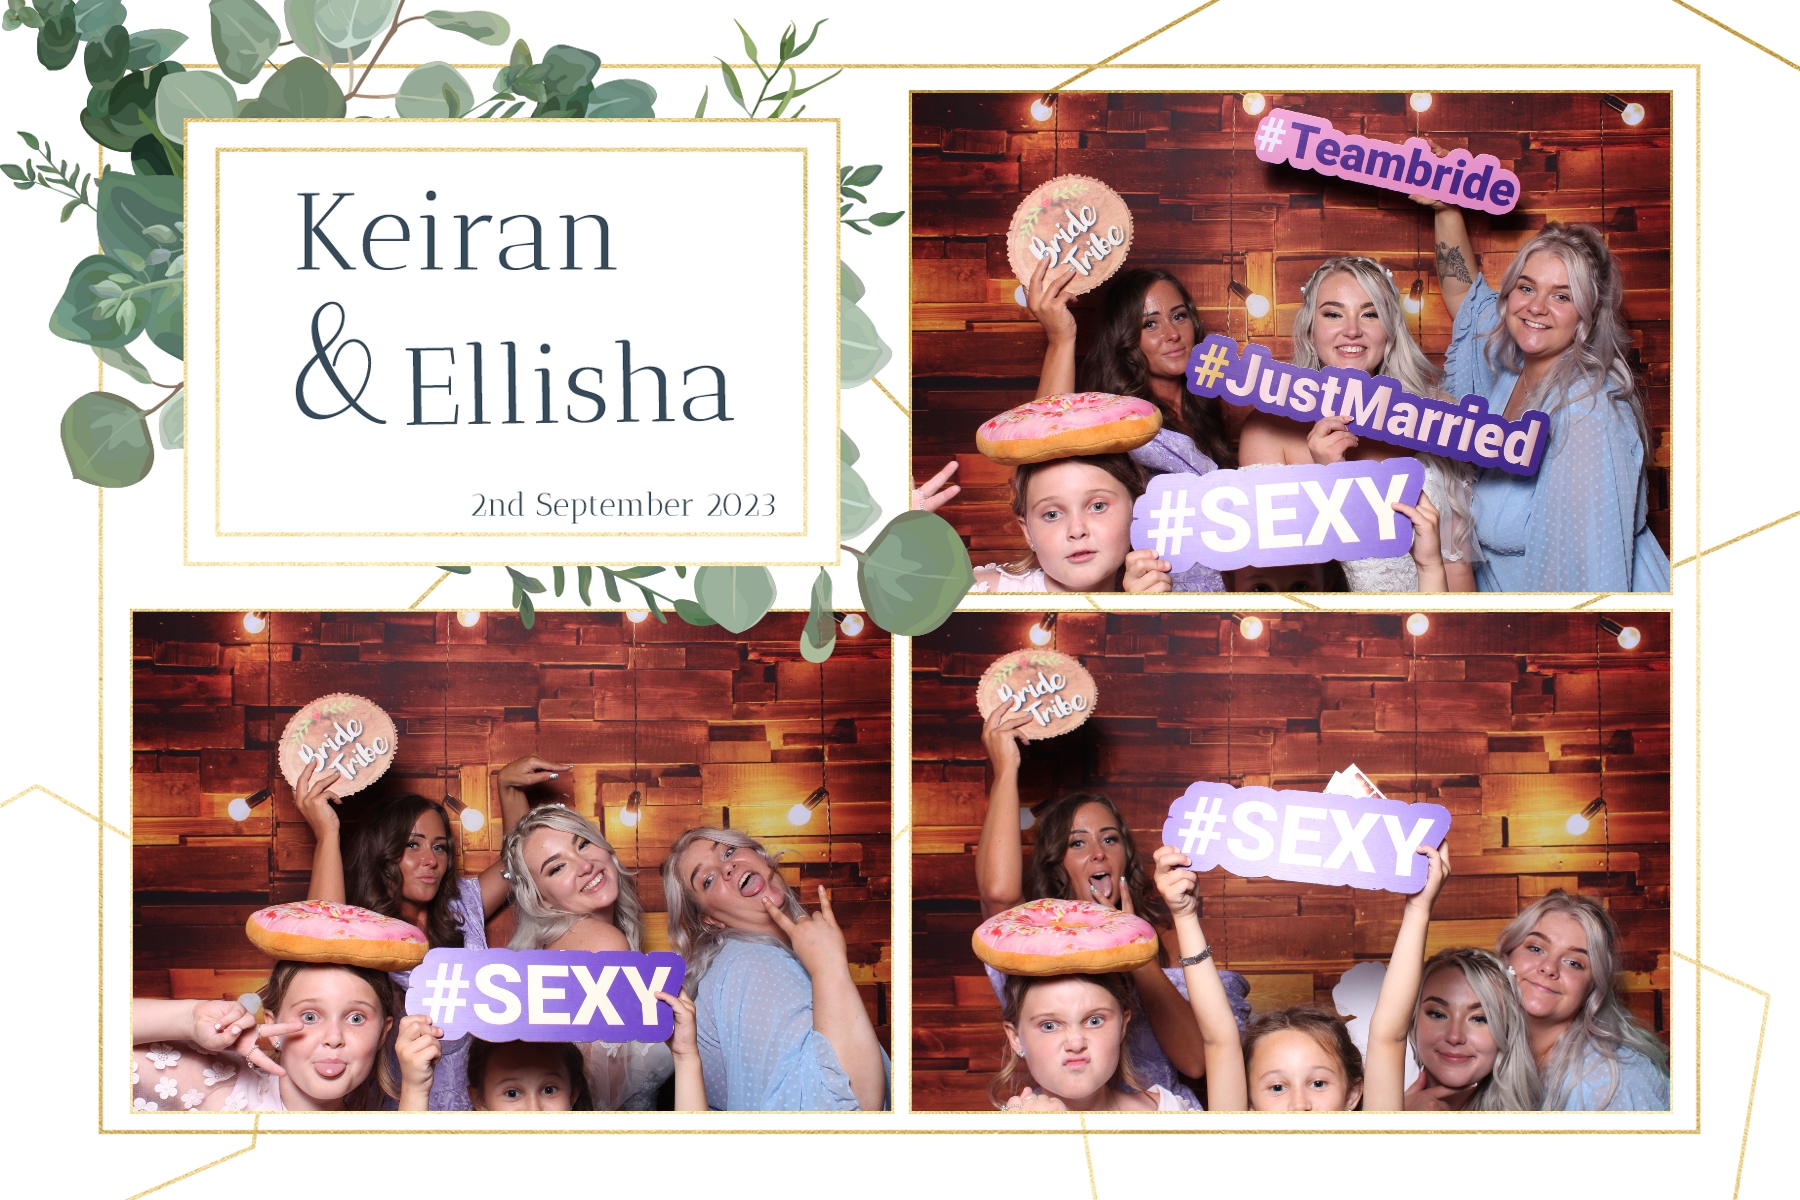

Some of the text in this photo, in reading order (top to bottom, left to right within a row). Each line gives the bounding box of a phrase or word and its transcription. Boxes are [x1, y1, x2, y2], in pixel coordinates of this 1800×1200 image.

[1257, 116, 1516, 206] #Teambride
[1028, 205, 1097, 269] Bride
[1060, 225, 1125, 276] Tribe
[1194, 343, 1542, 468] #JustMarried
[1147, 473, 1409, 557] #SEXY
[997, 671, 1066, 712] Bride
[1022, 694, 1087, 727] Tribe
[298, 718, 363, 772] Bride
[327, 736, 389, 780] Tribe
[1178, 796, 1435, 877] #SEXY
[422, 963, 672, 1026] #SEXY
